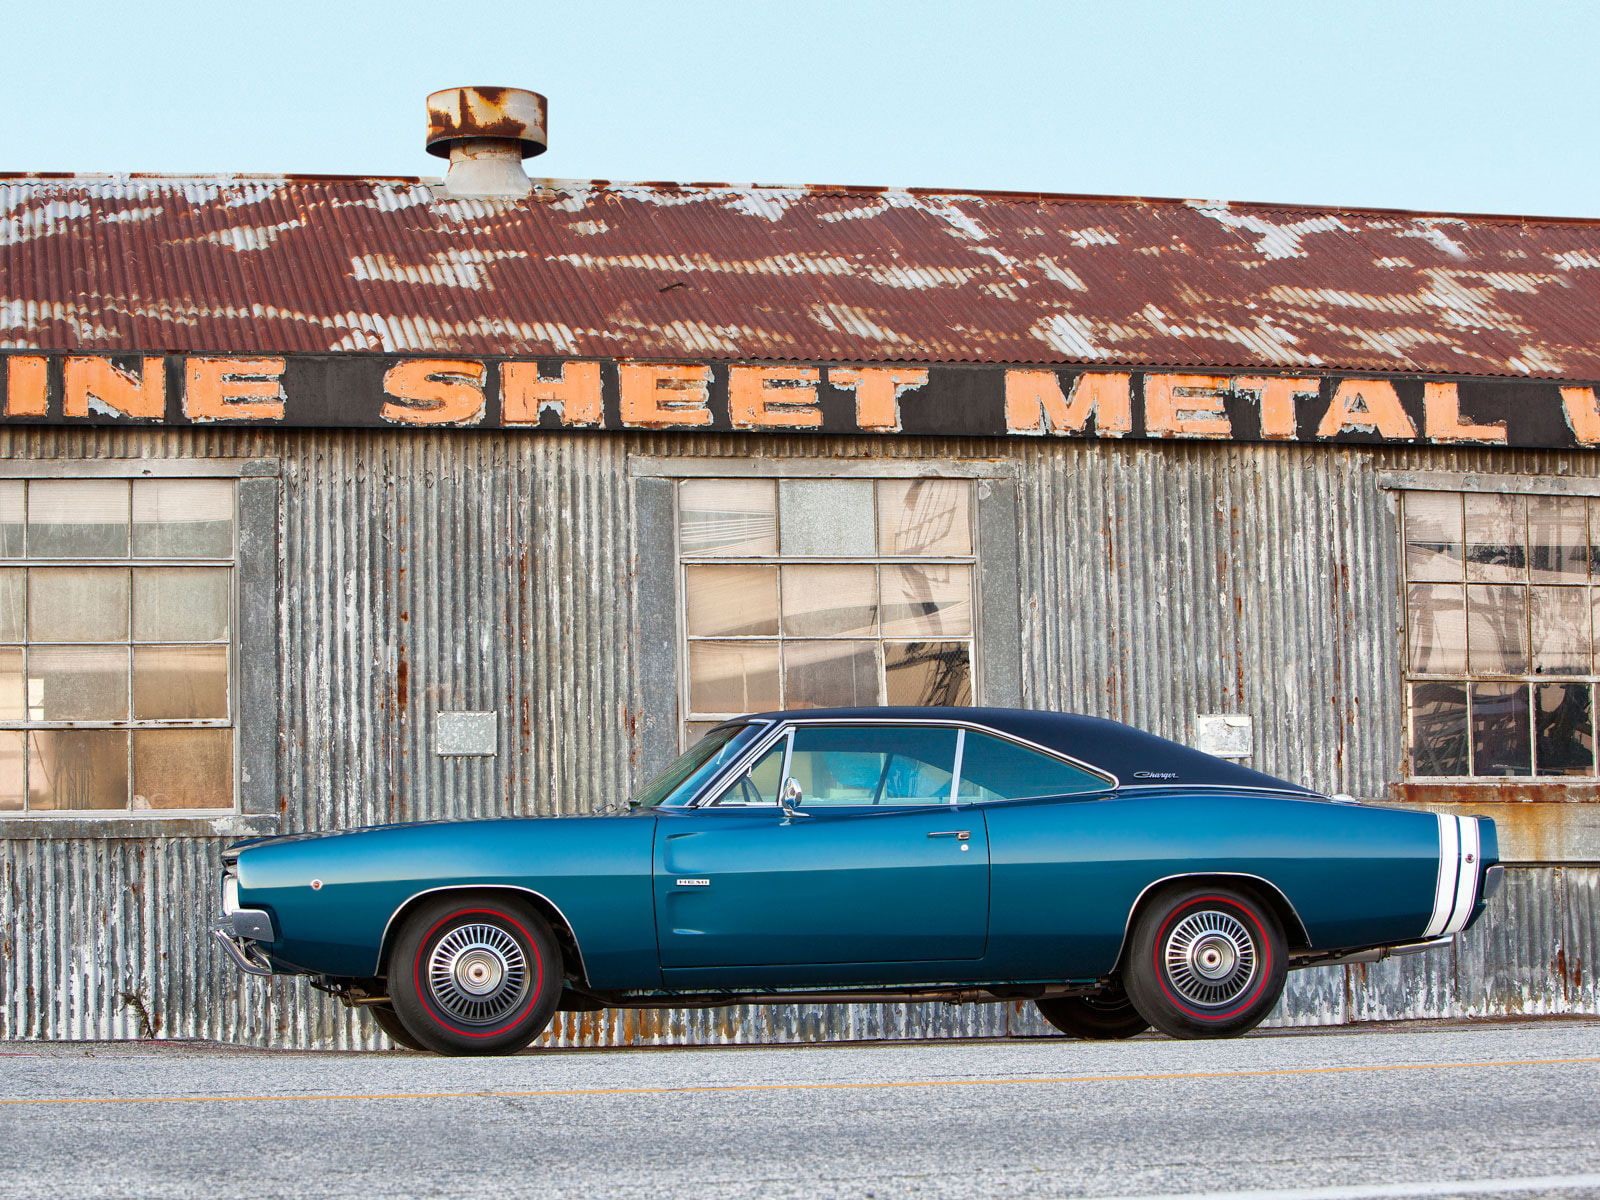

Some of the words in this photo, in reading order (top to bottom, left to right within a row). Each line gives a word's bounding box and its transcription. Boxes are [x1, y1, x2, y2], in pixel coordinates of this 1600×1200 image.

[3, 355, 287, 422] INE
[380, 360, 930, 431] SHEET
[1004, 370, 1508, 445] METAL
[1133, 771, 1179, 780] Charger
